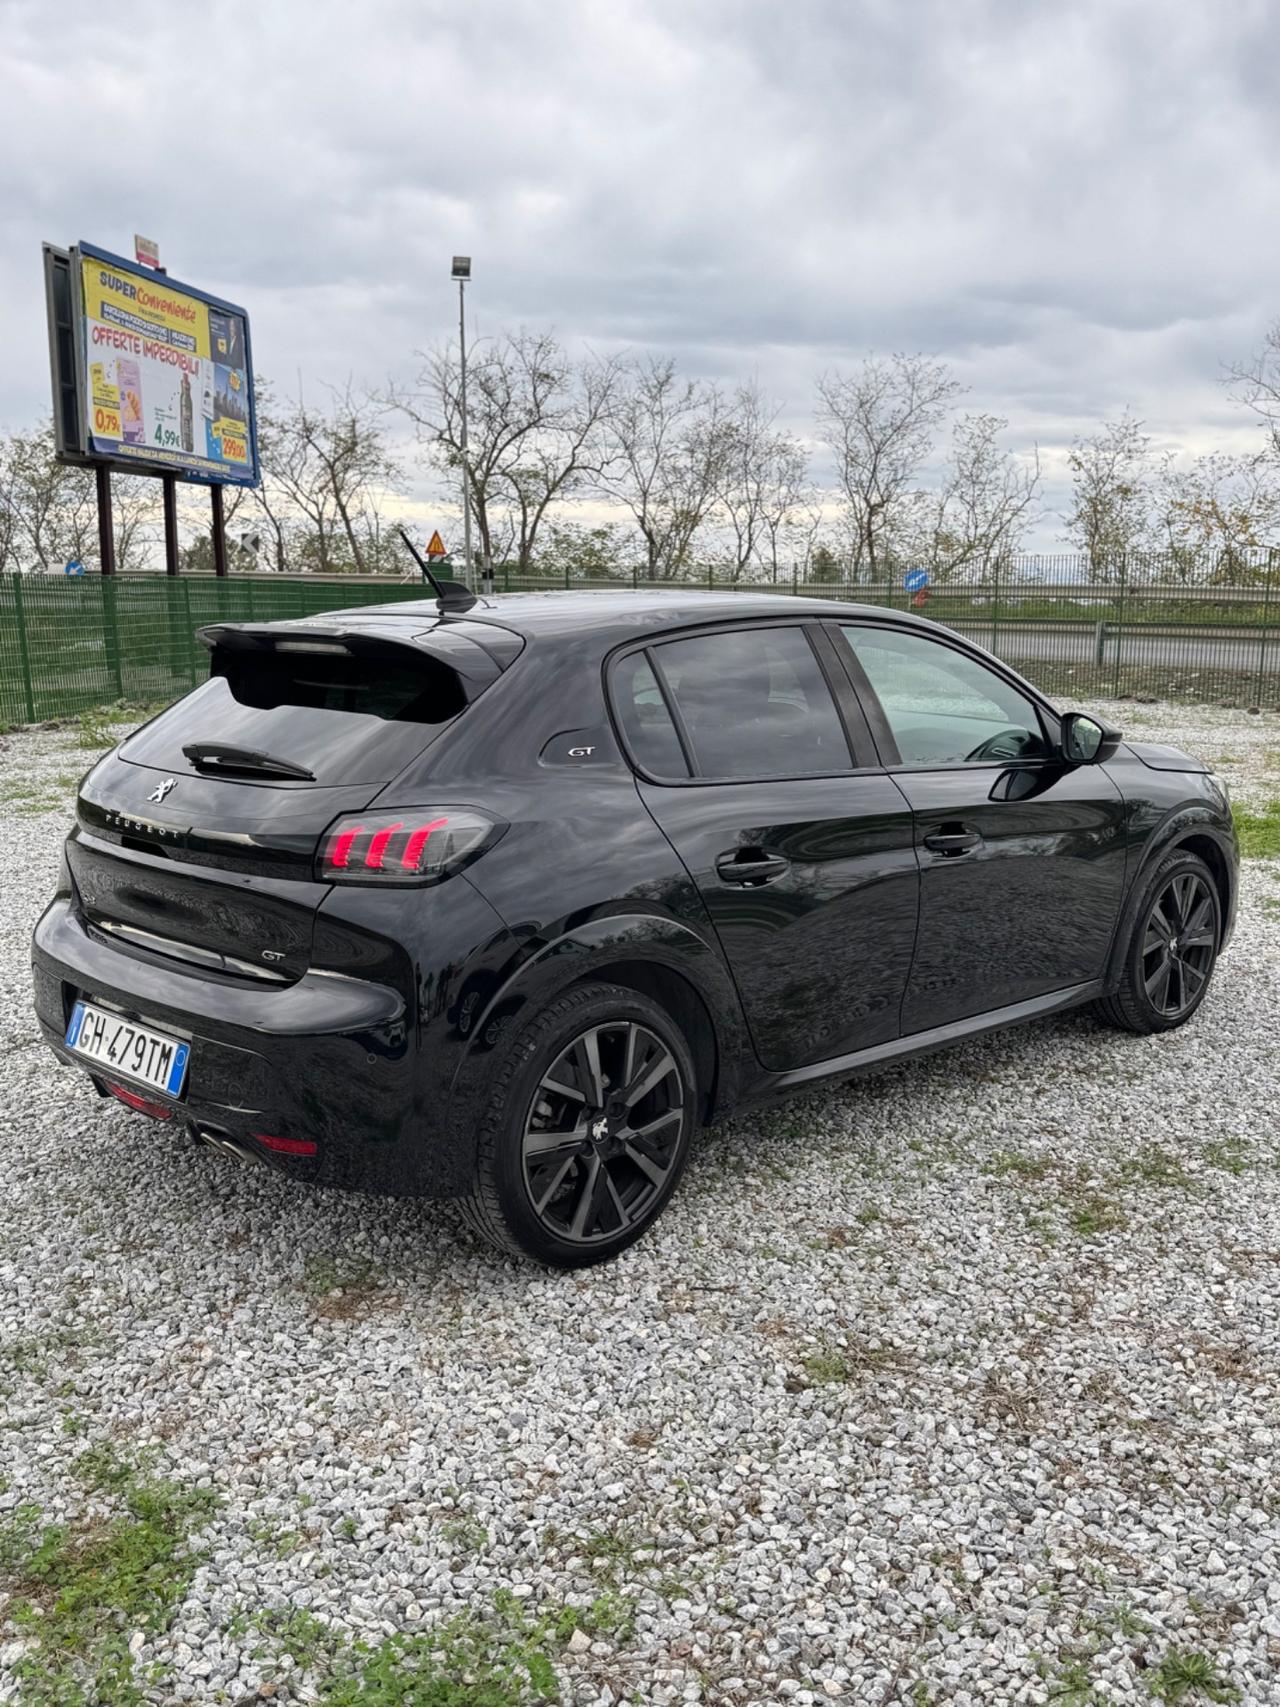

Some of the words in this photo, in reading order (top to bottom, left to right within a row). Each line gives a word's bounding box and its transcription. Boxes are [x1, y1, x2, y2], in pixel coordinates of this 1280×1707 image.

[91, 326, 141, 354] OFFERTE
[142, 339, 200, 377] IMPERDIBILI
[154, 424, 180, 447] 4,99€
[567, 746, 596, 757] GT
[105, 813, 180, 839] PEUGEOT
[261, 949, 286, 961] GT
